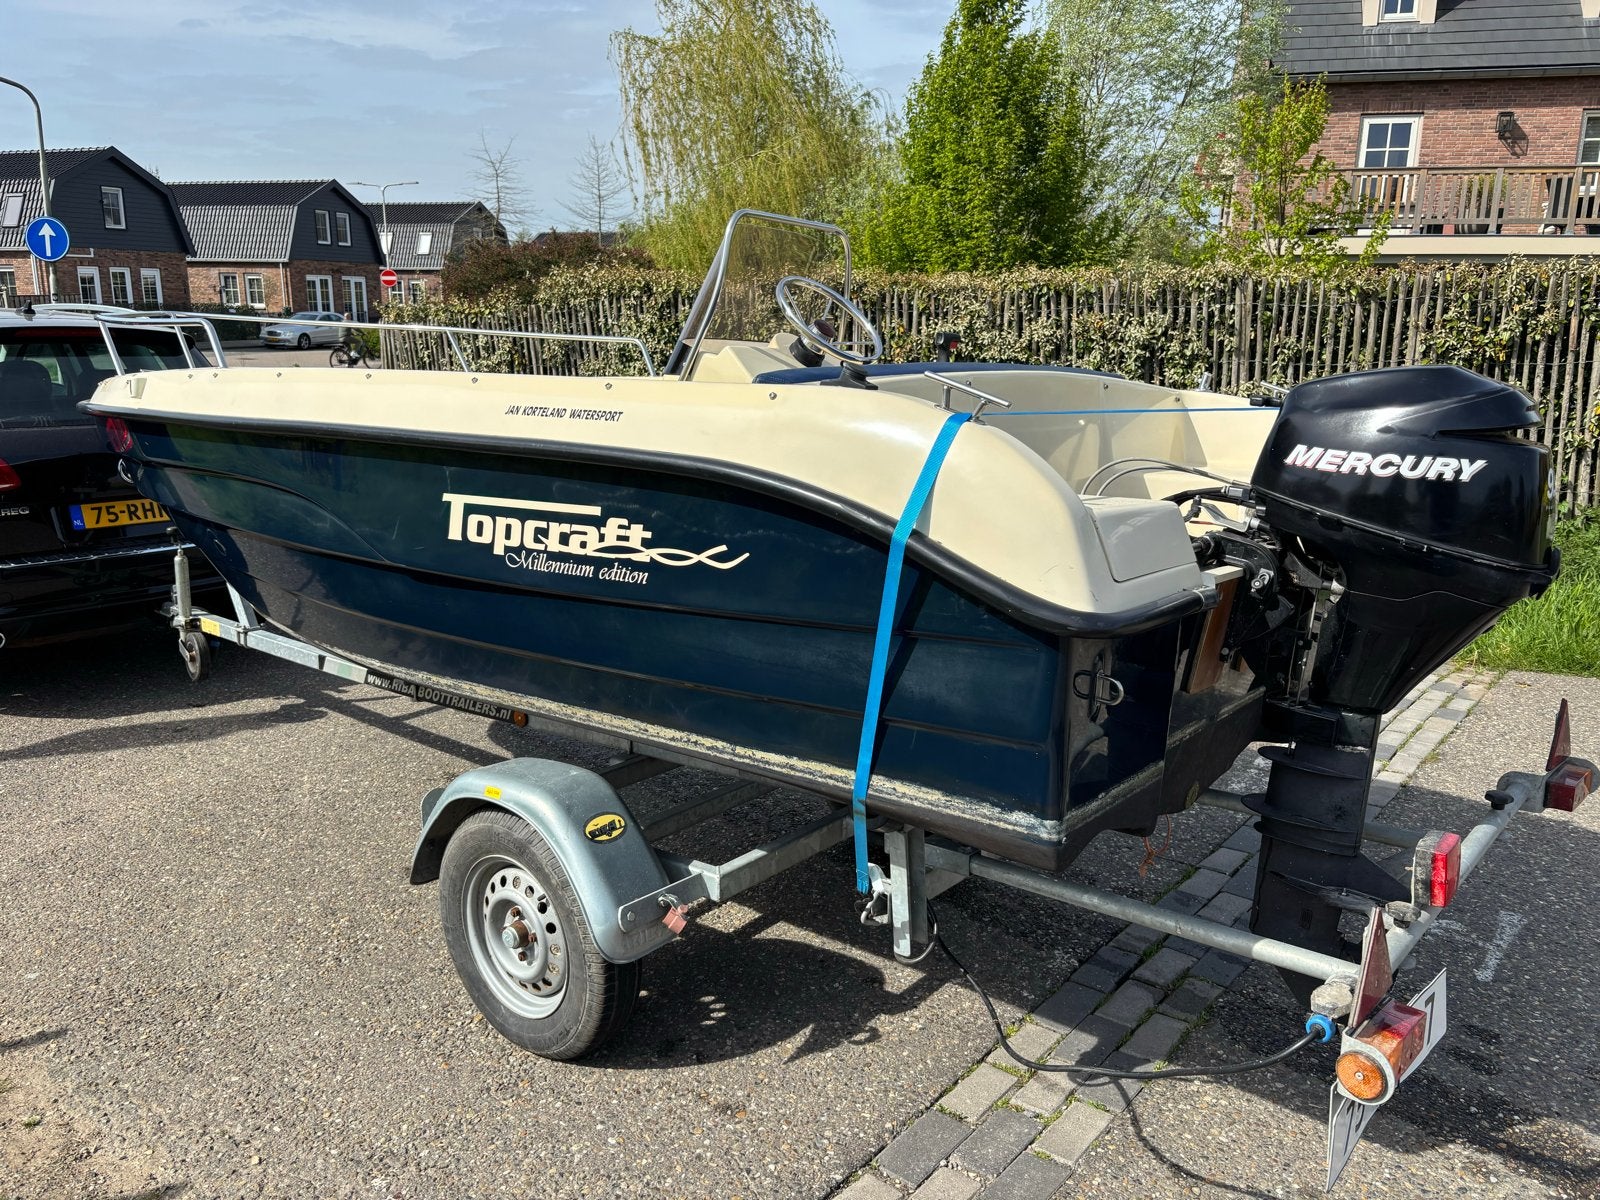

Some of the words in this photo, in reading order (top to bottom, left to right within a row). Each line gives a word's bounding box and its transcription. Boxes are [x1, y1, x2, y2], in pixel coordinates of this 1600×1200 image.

[505, 405, 521, 415] JAN
[522, 406, 567, 418] KORTELAND
[569, 408, 624, 422] WATERSPORT
[1283, 444, 1489, 483] MERCURY
[0, 506, 30, 516] REG
[73, 519, 84, 527] NL
[442, 492, 652, 562] Topcraft
[505, 550, 594, 578] Millennium
[598, 563, 649, 585] edition
